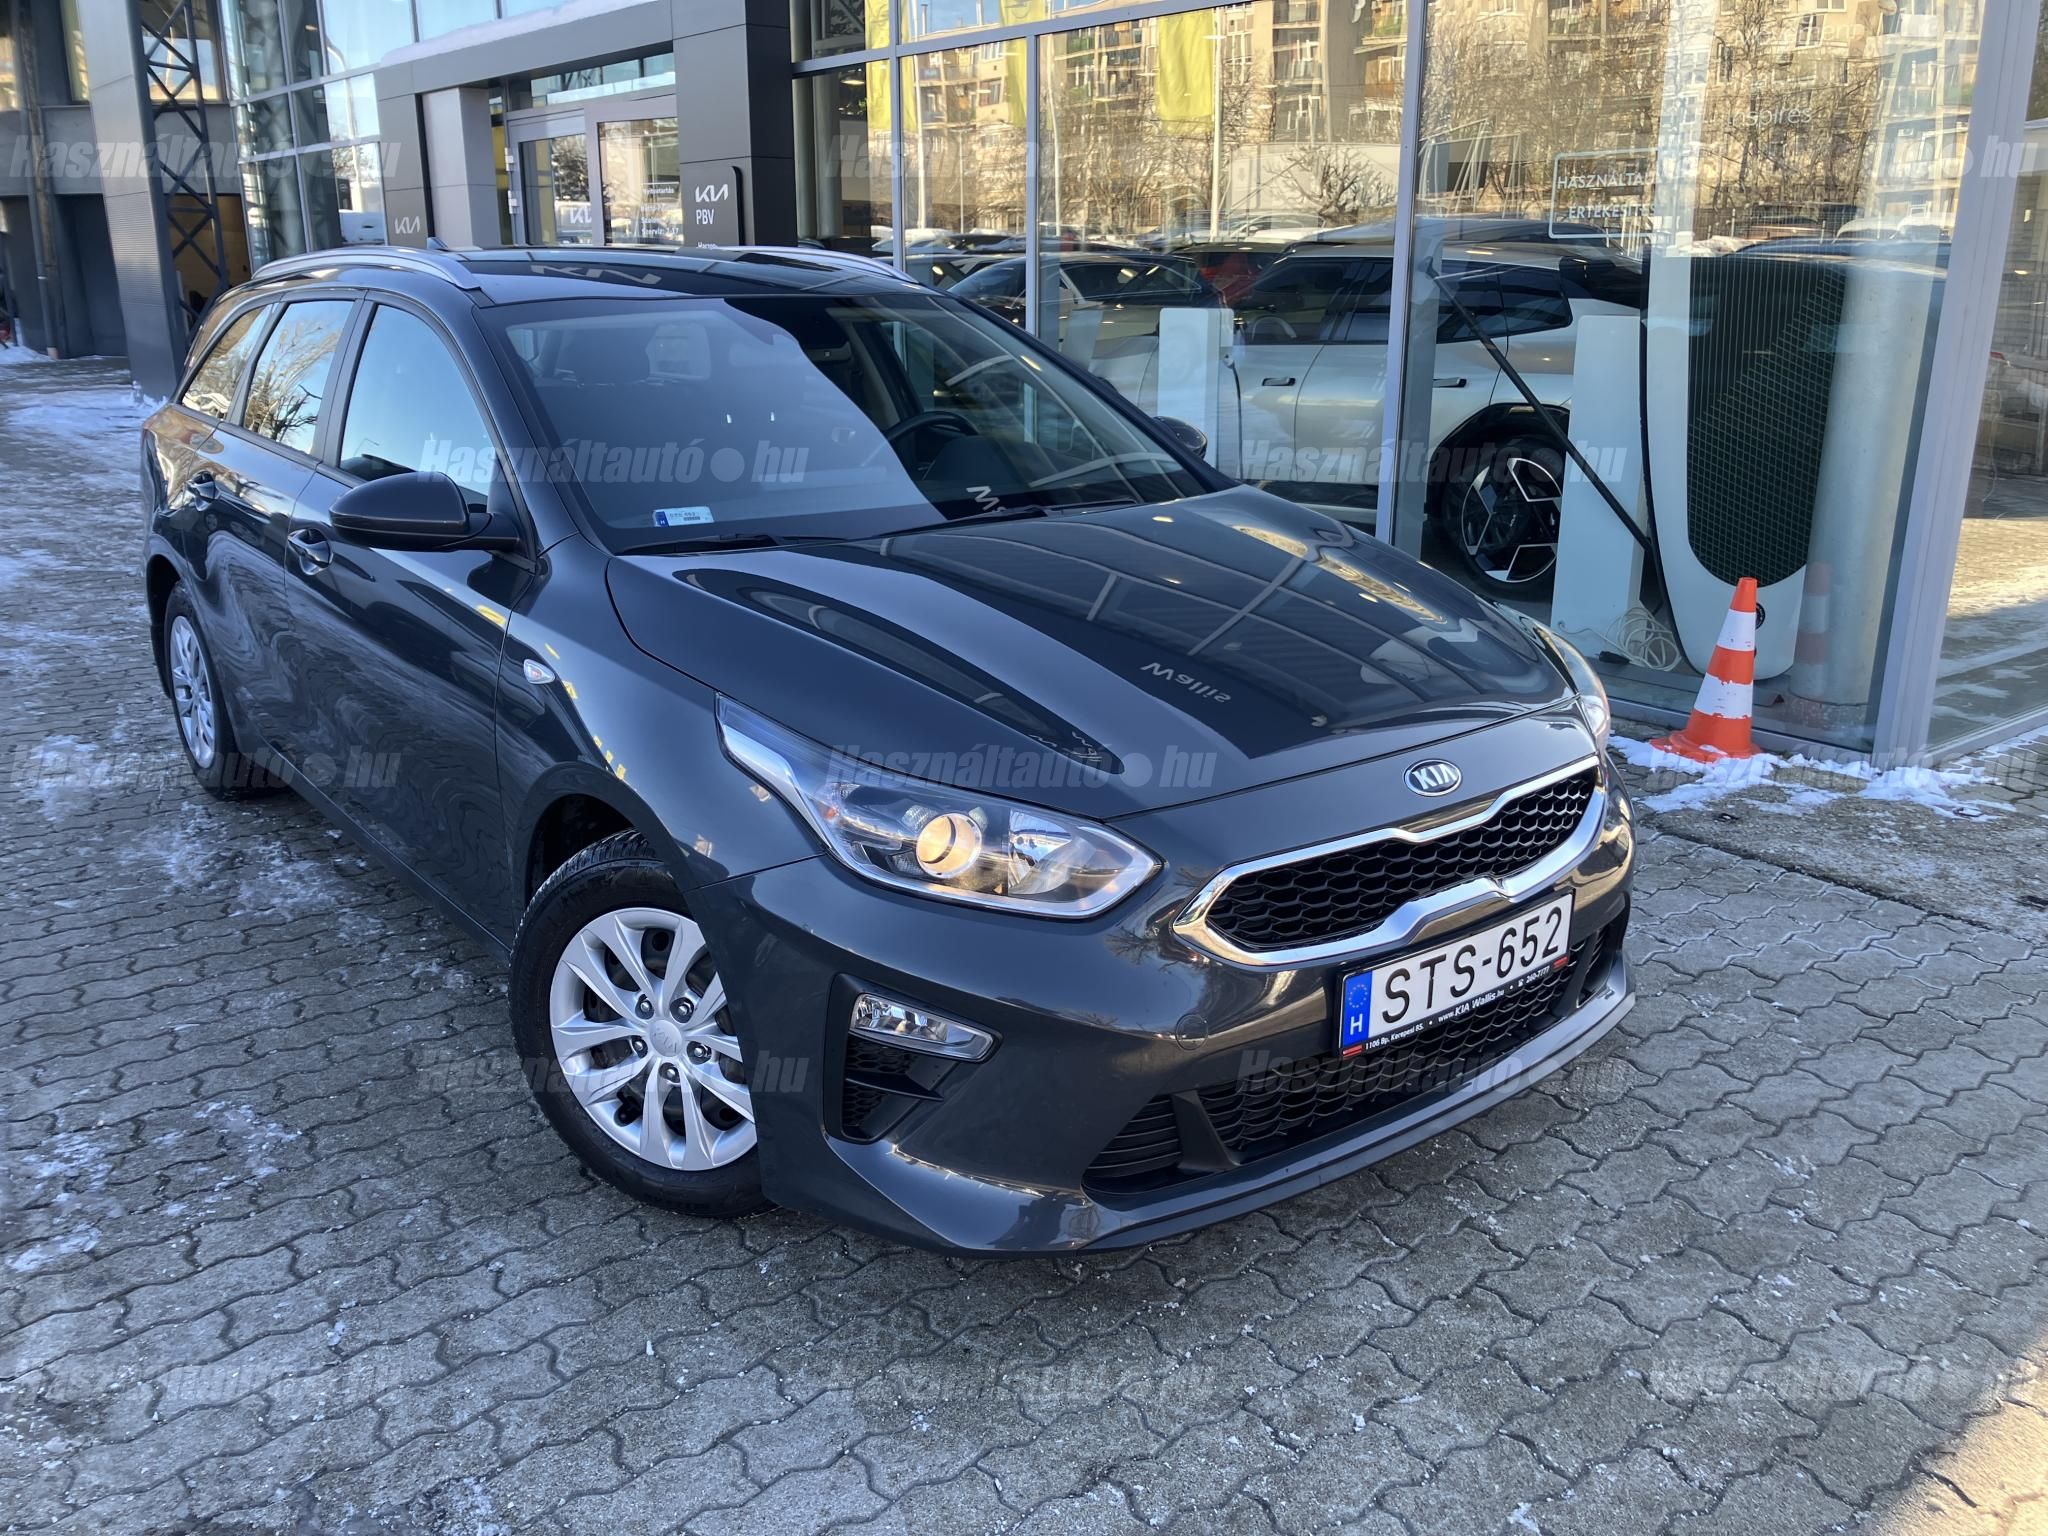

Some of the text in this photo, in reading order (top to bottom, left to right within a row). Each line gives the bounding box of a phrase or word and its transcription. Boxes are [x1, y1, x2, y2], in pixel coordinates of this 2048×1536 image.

[696, 209, 714, 225] PBV
[1411, 762, 1458, 790] KIA
[1381, 906, 1562, 1024] STS-652
[1350, 1013, 1363, 1036] H
[1365, 1039, 1380, 1050] 1106
